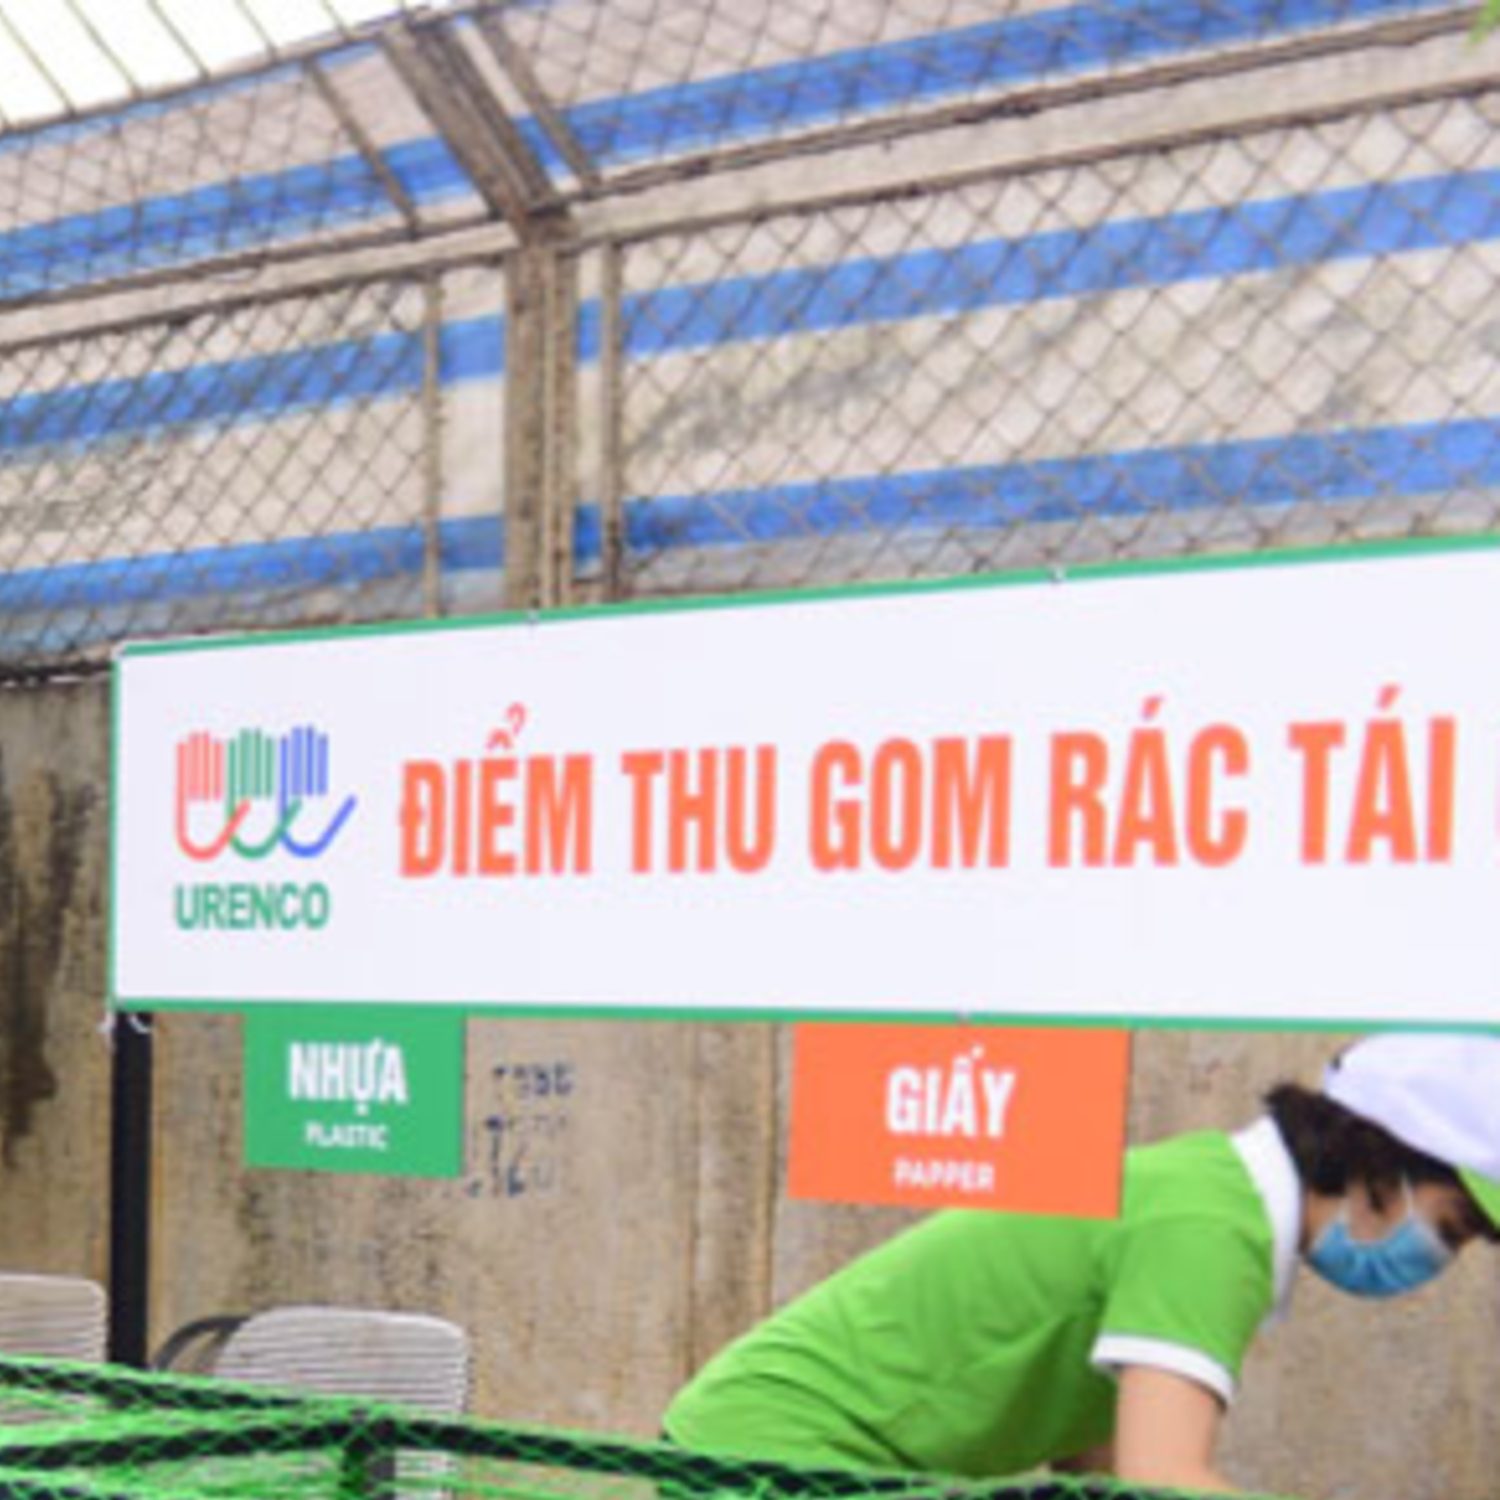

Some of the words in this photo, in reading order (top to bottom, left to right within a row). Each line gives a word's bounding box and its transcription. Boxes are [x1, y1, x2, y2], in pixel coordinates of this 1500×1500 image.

[399, 702, 593, 878] ĐIỂM
[621, 744, 778, 875] THU
[808, 733, 1012, 873] GOM
[1047, 695, 1249, 868] RÁC
[1287, 683, 1457, 865] TÁI
[174, 882, 331, 930] URENCO
[288, 1037, 409, 1116] NHỰA
[886, 1044, 1016, 1138] GIẤY
[305, 1121, 390, 1150] PLASTIC
[894, 1159, 995, 1192] PAPPER
